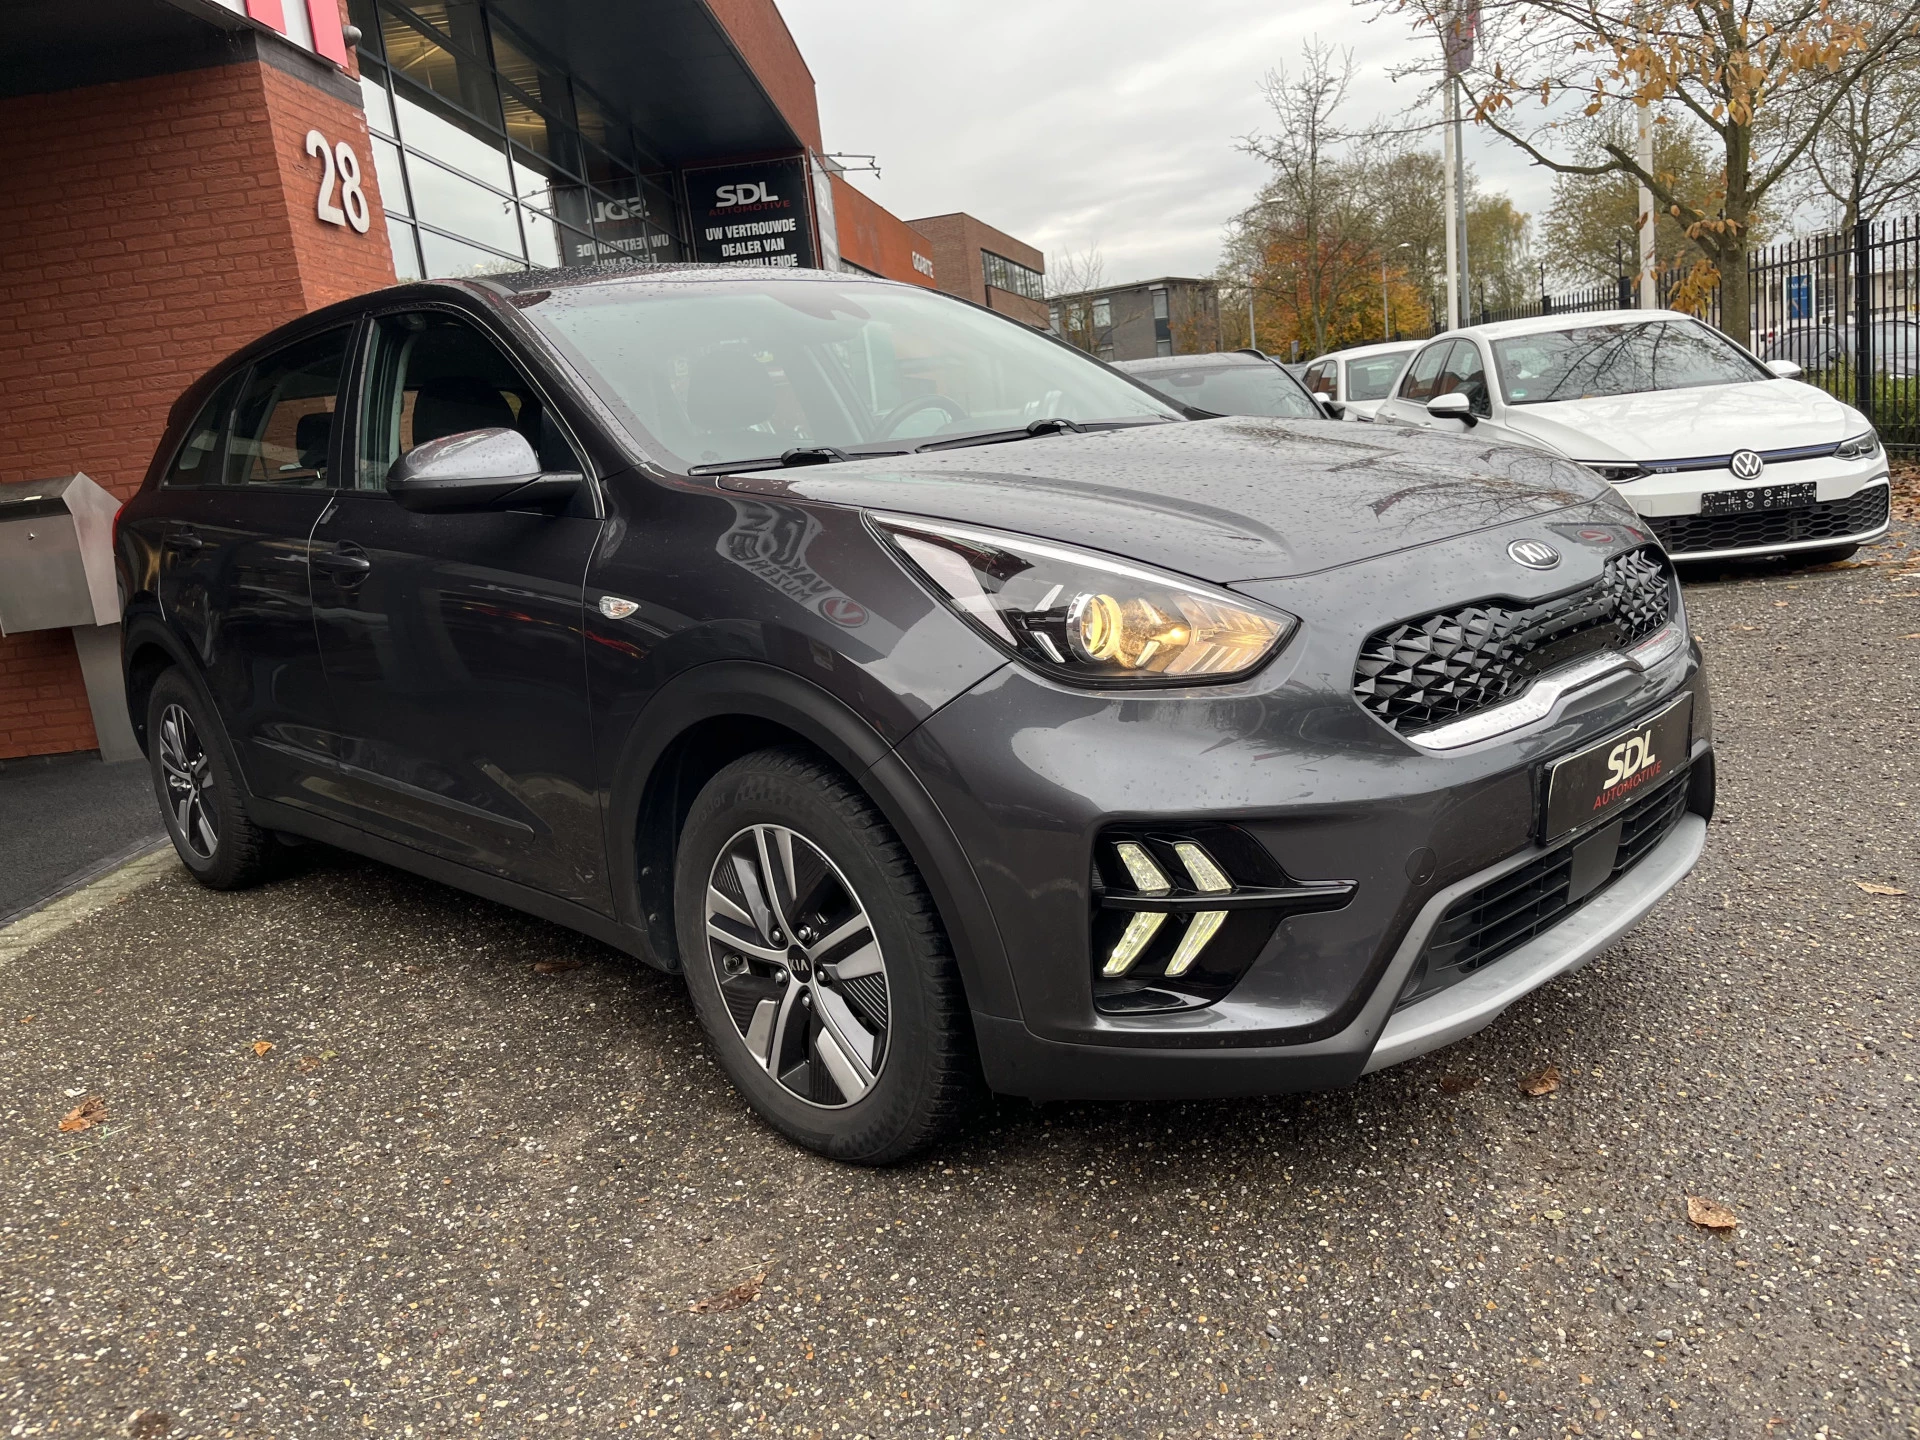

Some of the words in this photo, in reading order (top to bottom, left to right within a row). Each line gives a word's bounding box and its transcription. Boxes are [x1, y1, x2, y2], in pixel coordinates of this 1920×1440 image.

[306, 129, 370, 233] 28
[716, 181, 779, 207] SDL
[709, 200, 790, 217] AUTOMOTIVE
[705, 227, 723, 241] UW
[725, 218, 797, 239] VERTROUWDE
[721, 241, 761, 257] DEALER
[763, 237, 785, 252] VAN
[1603, 729, 1656, 790] SDL
[1592, 759, 1663, 810] AUTOMOTIVE
[788, 959, 810, 971] KIA
